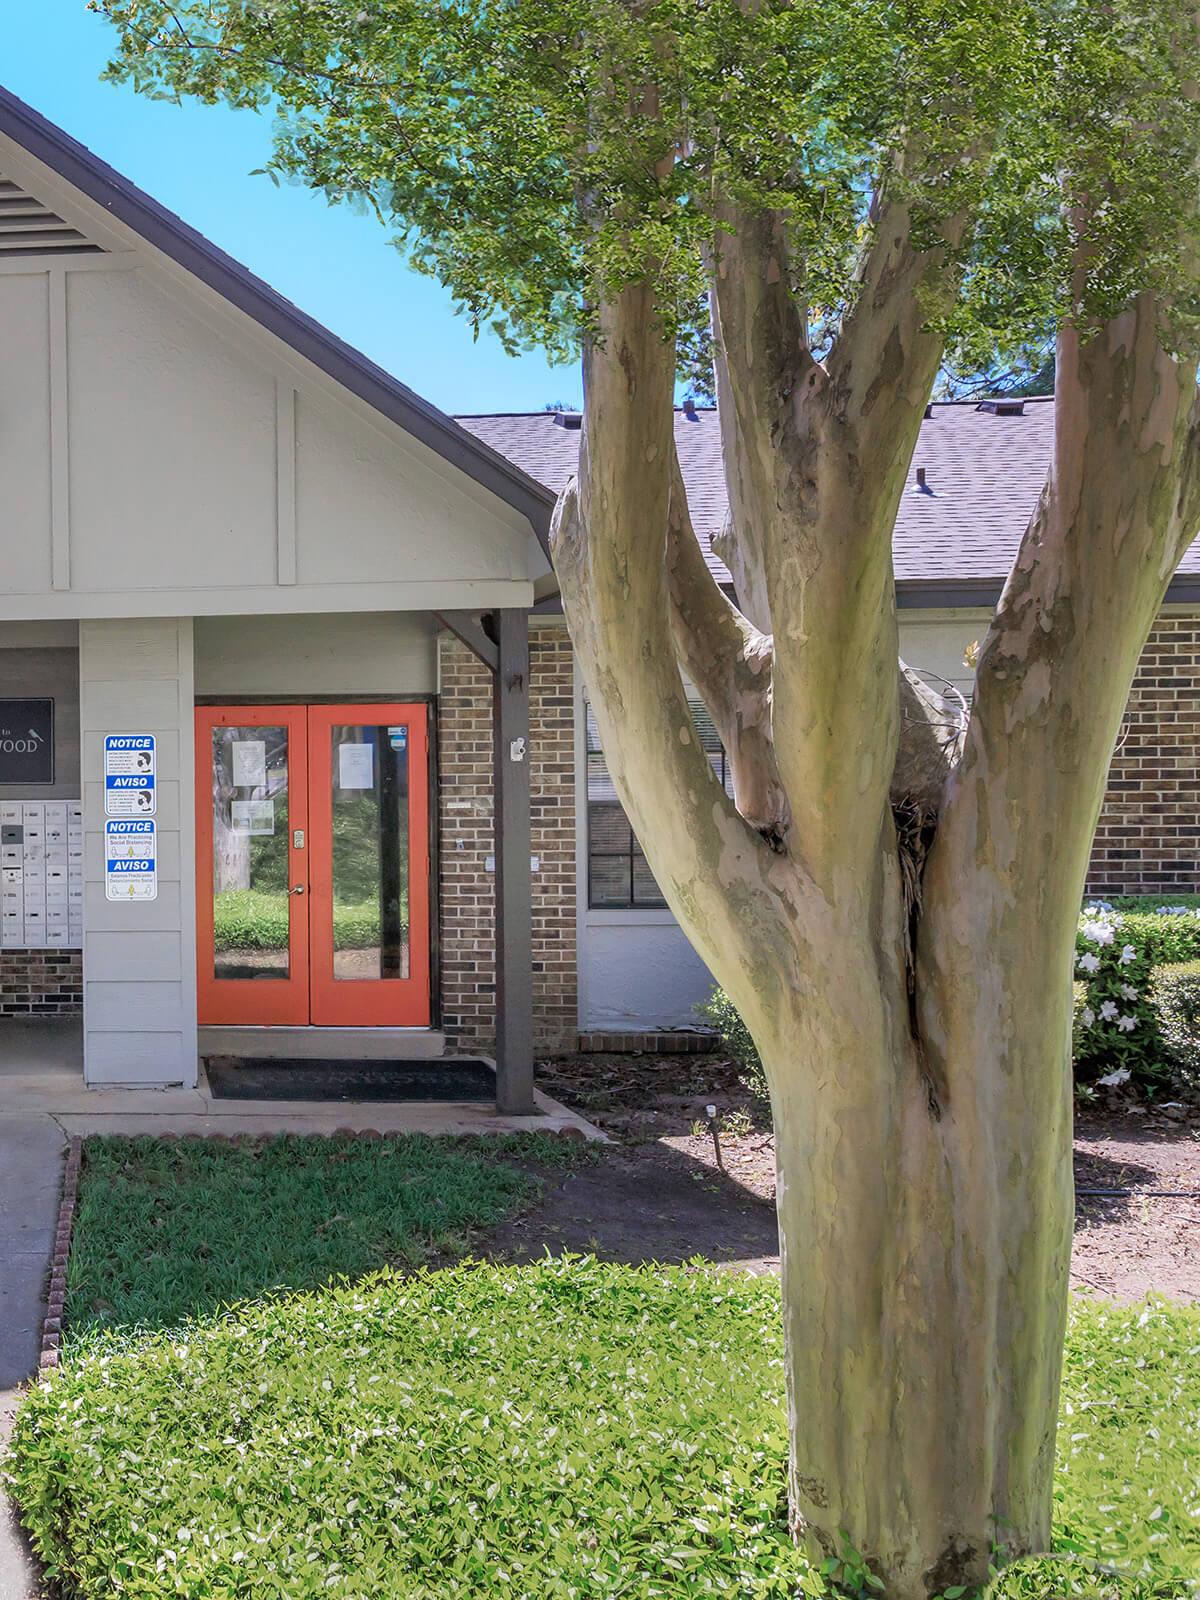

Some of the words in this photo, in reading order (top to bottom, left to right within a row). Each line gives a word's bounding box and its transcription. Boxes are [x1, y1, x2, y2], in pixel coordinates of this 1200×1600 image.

[1, 728, 11, 736] to
[109, 738, 151, 748] NOTICE
[113, 777, 148, 787] AVISO
[109, 822, 152, 832] NOTICE
[114, 861, 149, 871] AVISO
